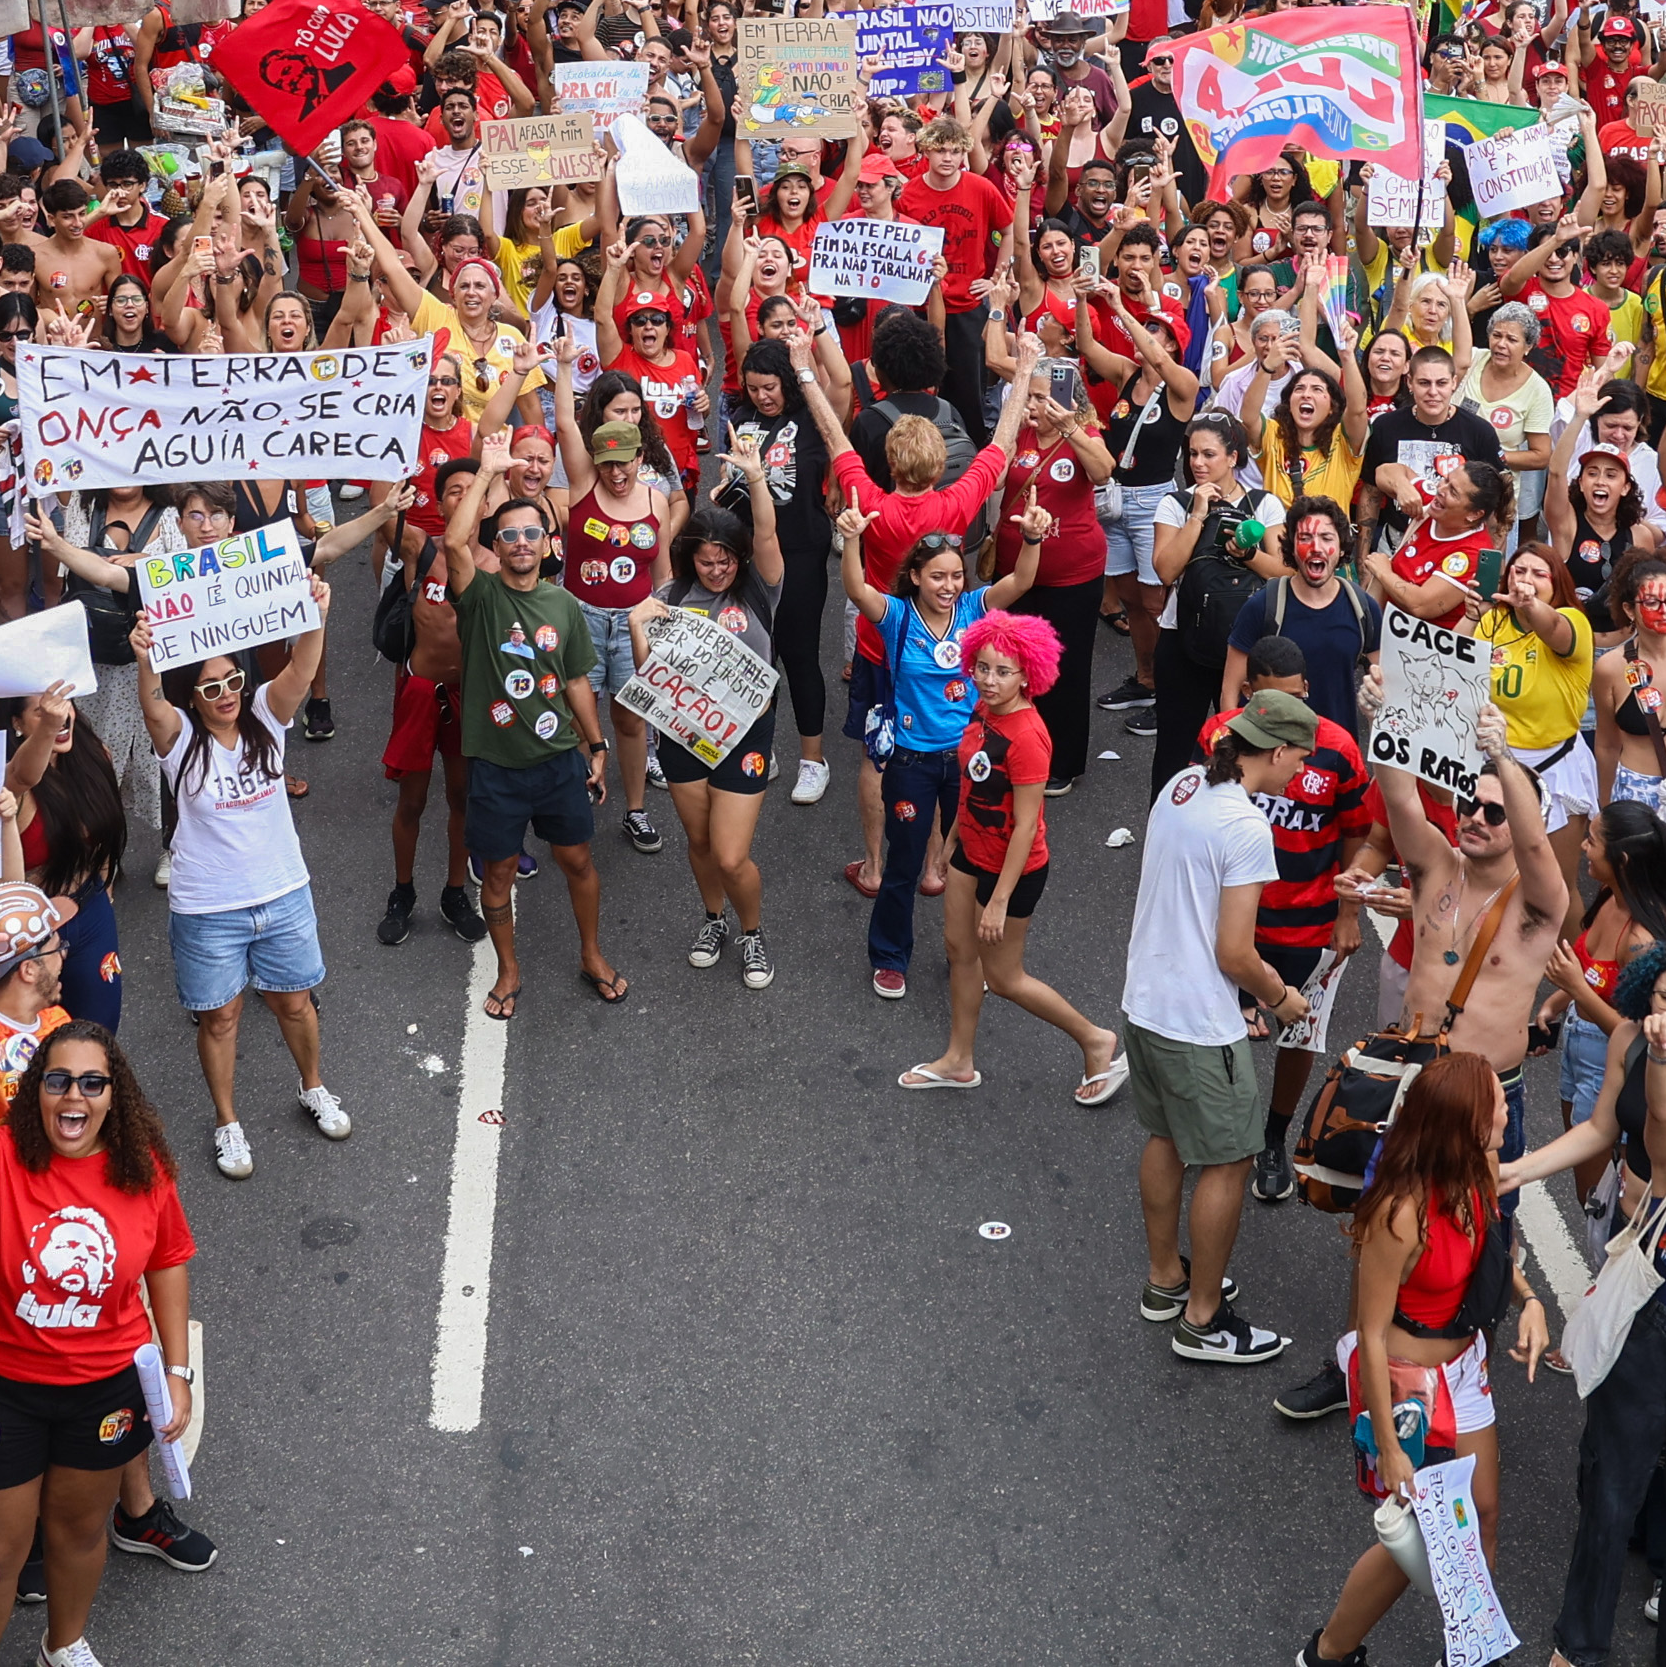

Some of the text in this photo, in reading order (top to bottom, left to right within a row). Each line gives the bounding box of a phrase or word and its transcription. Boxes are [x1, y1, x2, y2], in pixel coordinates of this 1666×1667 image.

[917, 6, 954, 28] NÃO
[314, 13, 359, 62] LULA
[744, 21, 839, 44] EM TERRA
[744, 45, 765, 60] DE
[820, 44, 850, 60] JOSÉ
[789, 61, 813, 73] PATO
[562, 80, 591, 99] PRA
[792, 70, 847, 93] NÃO SE
[818, 94, 851, 109] CRIA
[519, 123, 557, 143] AFASTA
[561, 128, 583, 141] MIM
[1479, 136, 1520, 158] NOSSA
[491, 154, 599, 181] ESSE CALE-SE
[1477, 156, 1553, 203] CONSTITUIÇÃO
[831, 223, 921, 244] VOTE PELO
[813, 235, 912, 263] FIM DA ESCALA
[916, 249, 927, 265] 6
[813, 253, 838, 270] PRA
[842, 254, 866, 274] NÃO
[834, 272, 850, 286] NA
[40, 352, 399, 403] EM TERRA DE
[37, 386, 417, 452] ONÇA NÃO SE CRIA
[262, 426, 406, 463] CARECA
[145, 529, 286, 589] BRASIL
[144, 562, 311, 622] NÃO QUINTAL
[206, 575, 227, 607] É
[151, 599, 307, 664] DE NINGUÉM
[1388, 611, 1476, 664] CACE
[647, 626, 764, 709] SABER LIRISMO
[686, 617, 770, 691] QUERO MAIS
[665, 649, 715, 693] NÃO É
[669, 716, 695, 743] LULA
[1373, 731, 1477, 798] OS RATOS
[214, 768, 270, 802] 1964
